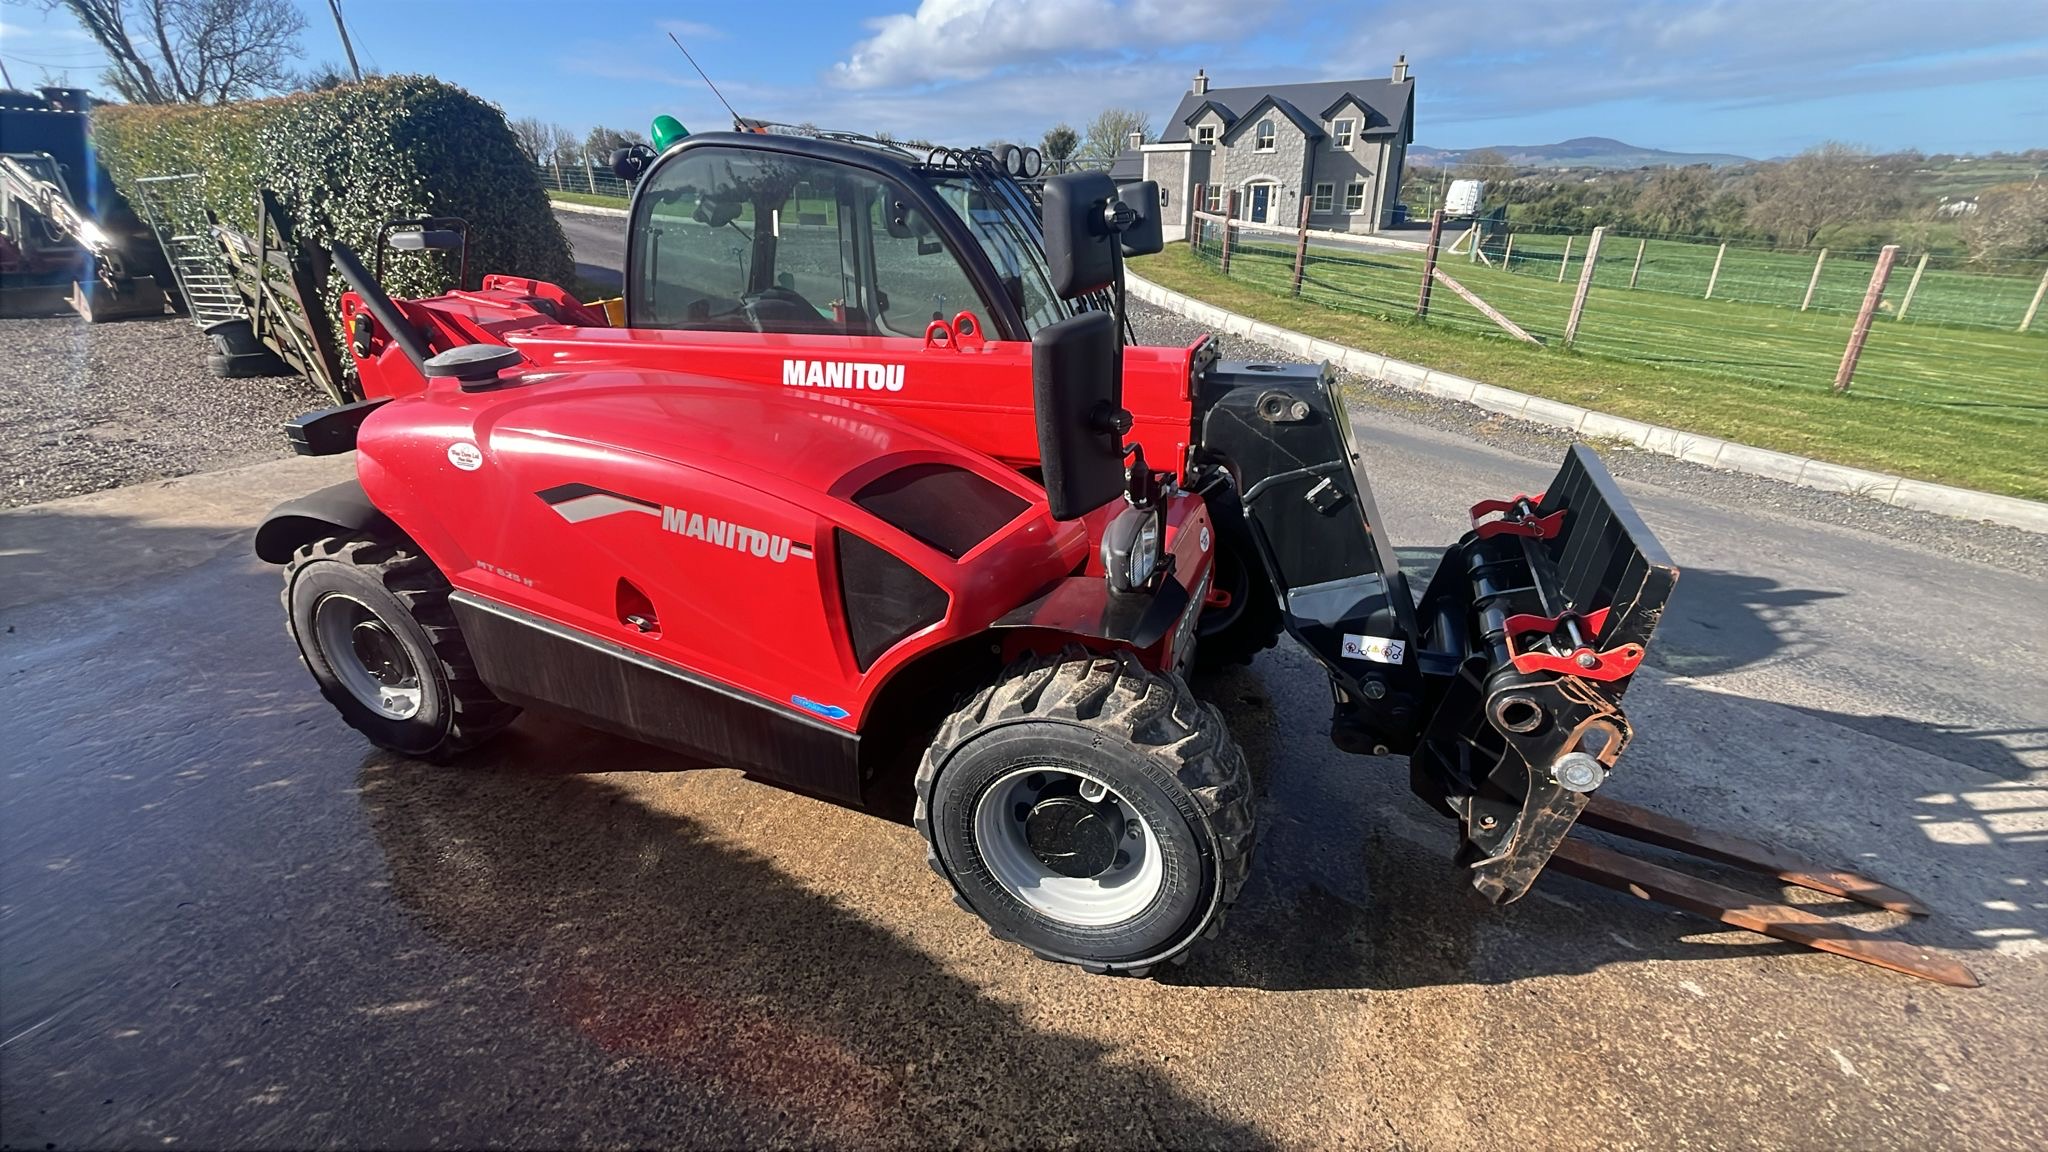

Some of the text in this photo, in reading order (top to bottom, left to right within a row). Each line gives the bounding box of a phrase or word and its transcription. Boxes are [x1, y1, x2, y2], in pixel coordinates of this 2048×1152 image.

[783, 359, 905, 392] MANITOU
[661, 505, 791, 564] MANITOU
[476, 560, 533, 587] MT 625 H
[1140, 764, 1198, 823] ALLIANCE
